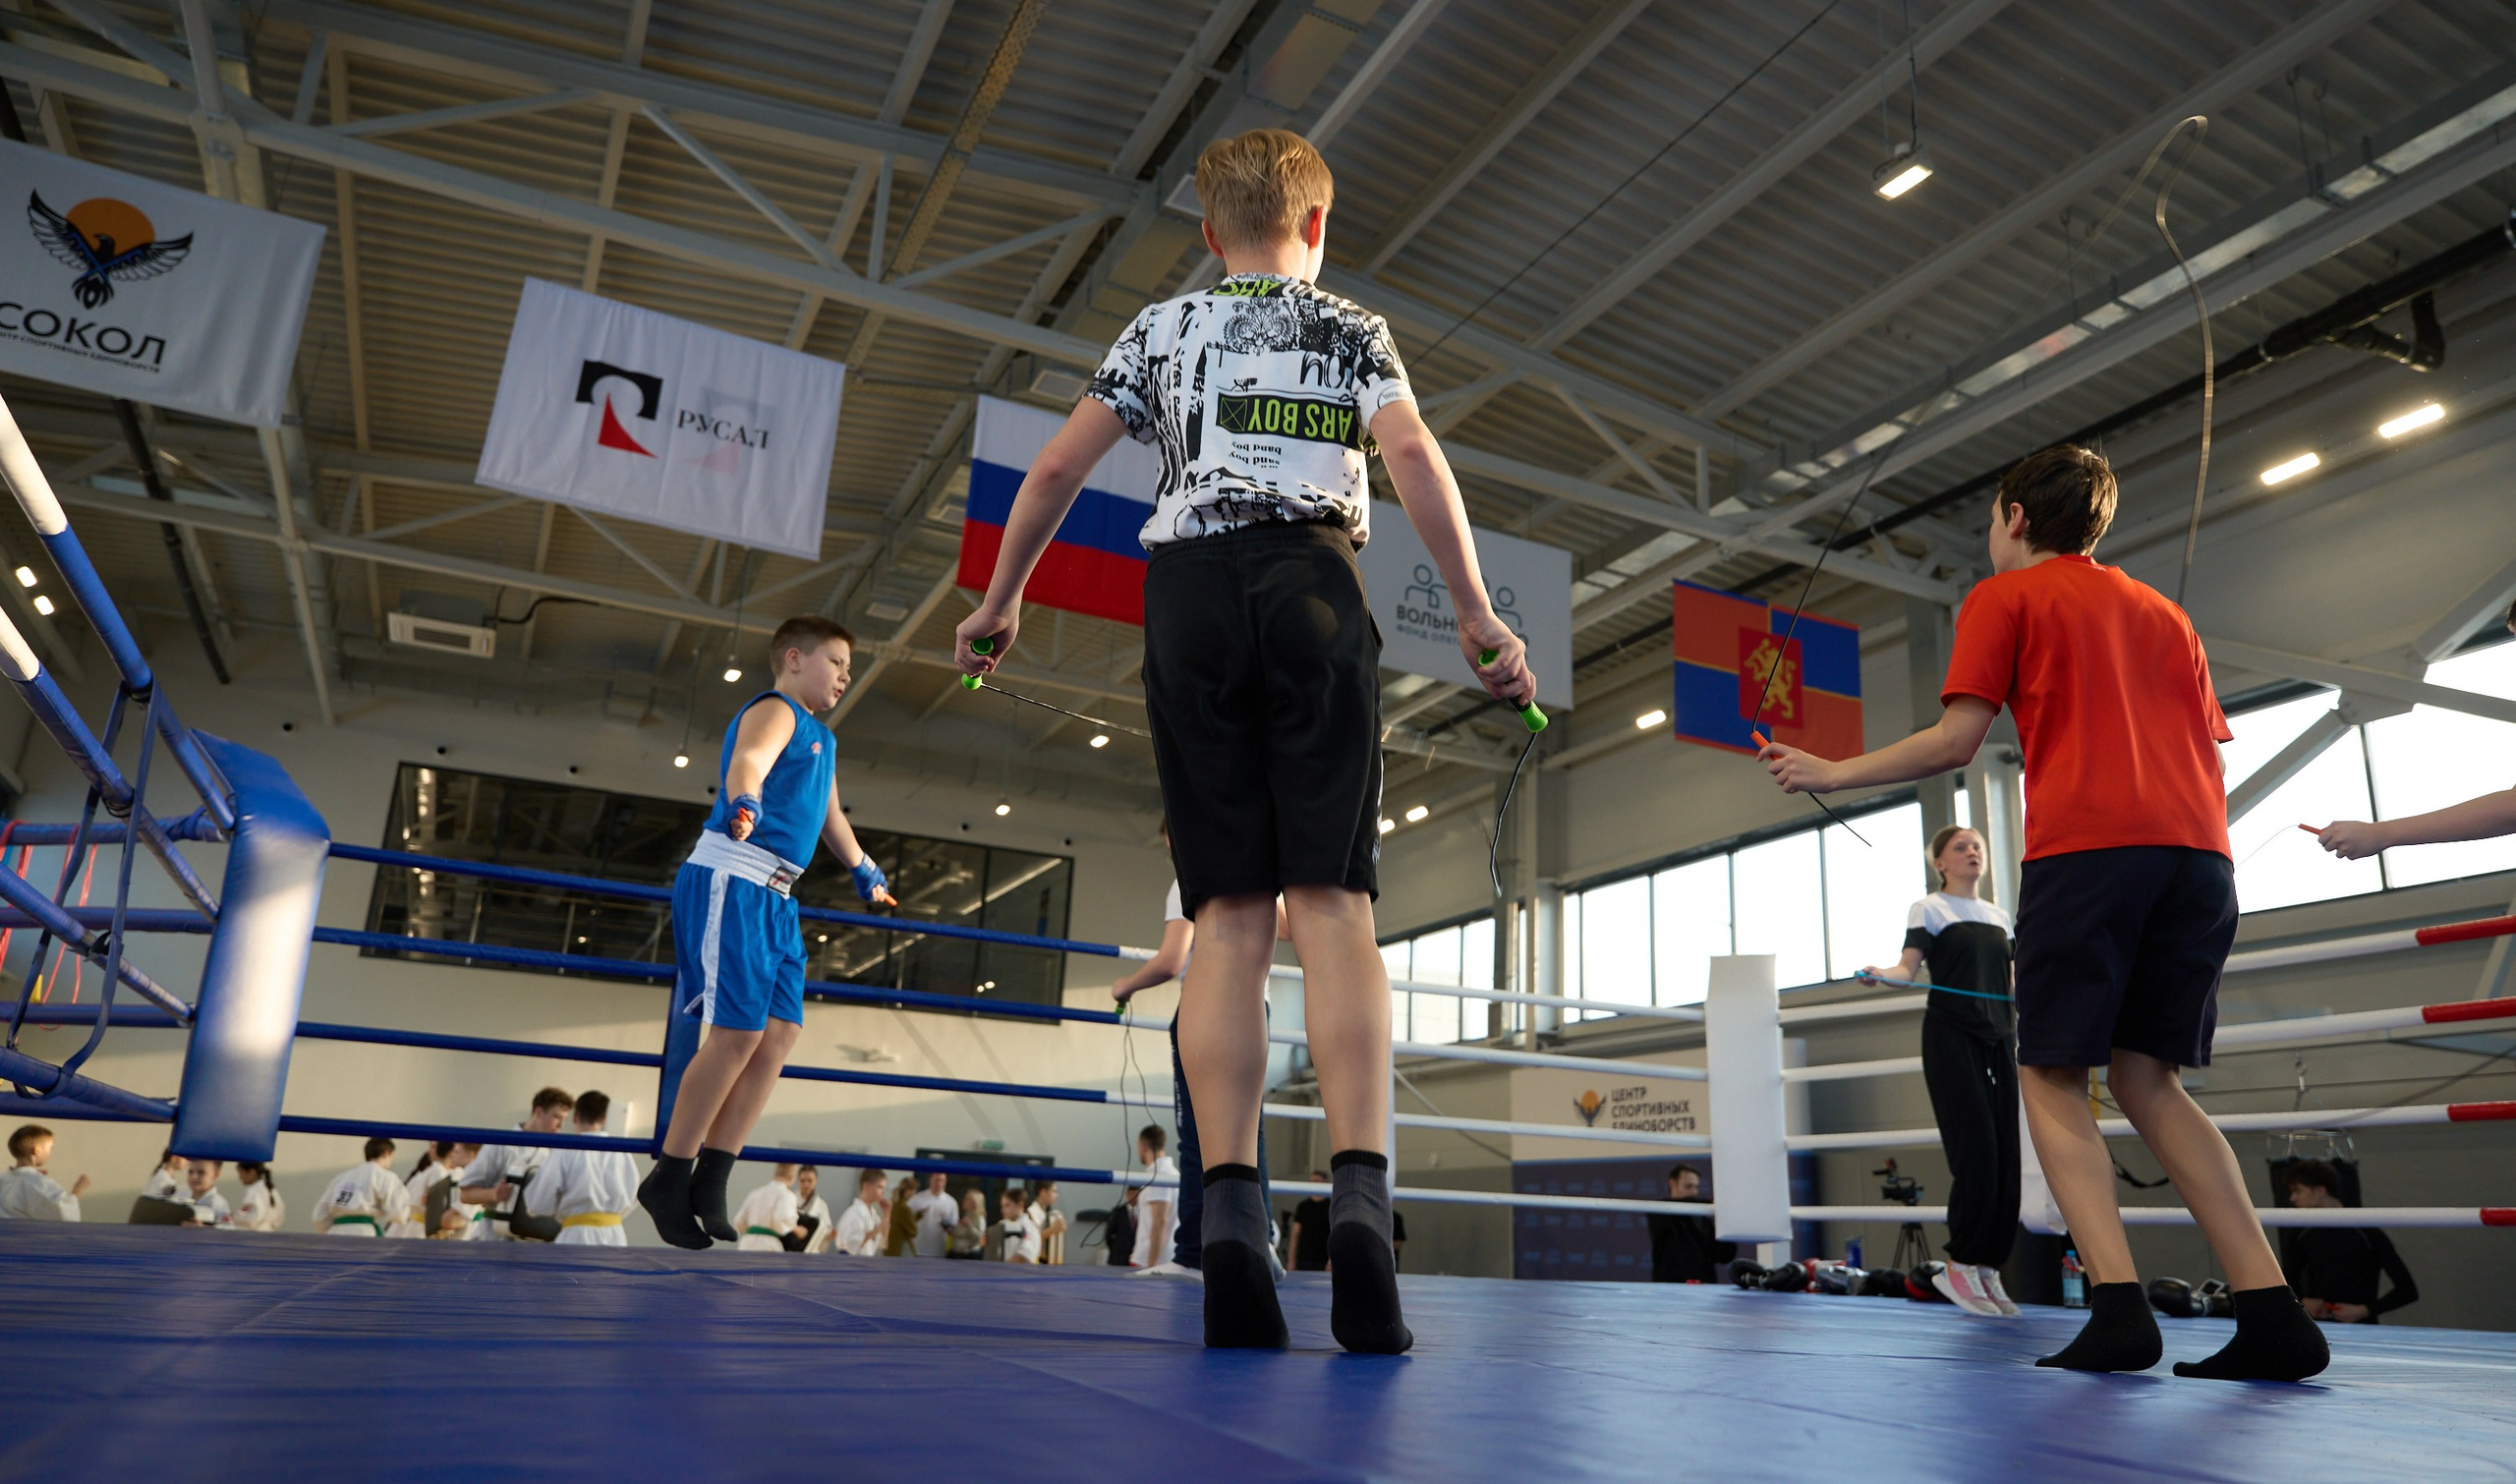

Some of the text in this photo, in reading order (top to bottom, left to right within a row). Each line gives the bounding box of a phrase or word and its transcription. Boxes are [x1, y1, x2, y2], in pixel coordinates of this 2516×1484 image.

[0, 302, 167, 366] СОКОЛ
[677, 409, 770, 449] РУСАЛ
[1247, 397, 1299, 435] BOY
[1397, 604, 1458, 631] ВОЛЬН
[1611, 1086, 1647, 1102] ЦЕНТР
[1611, 1100, 1689, 1118] СПОРТИВНЫХ
